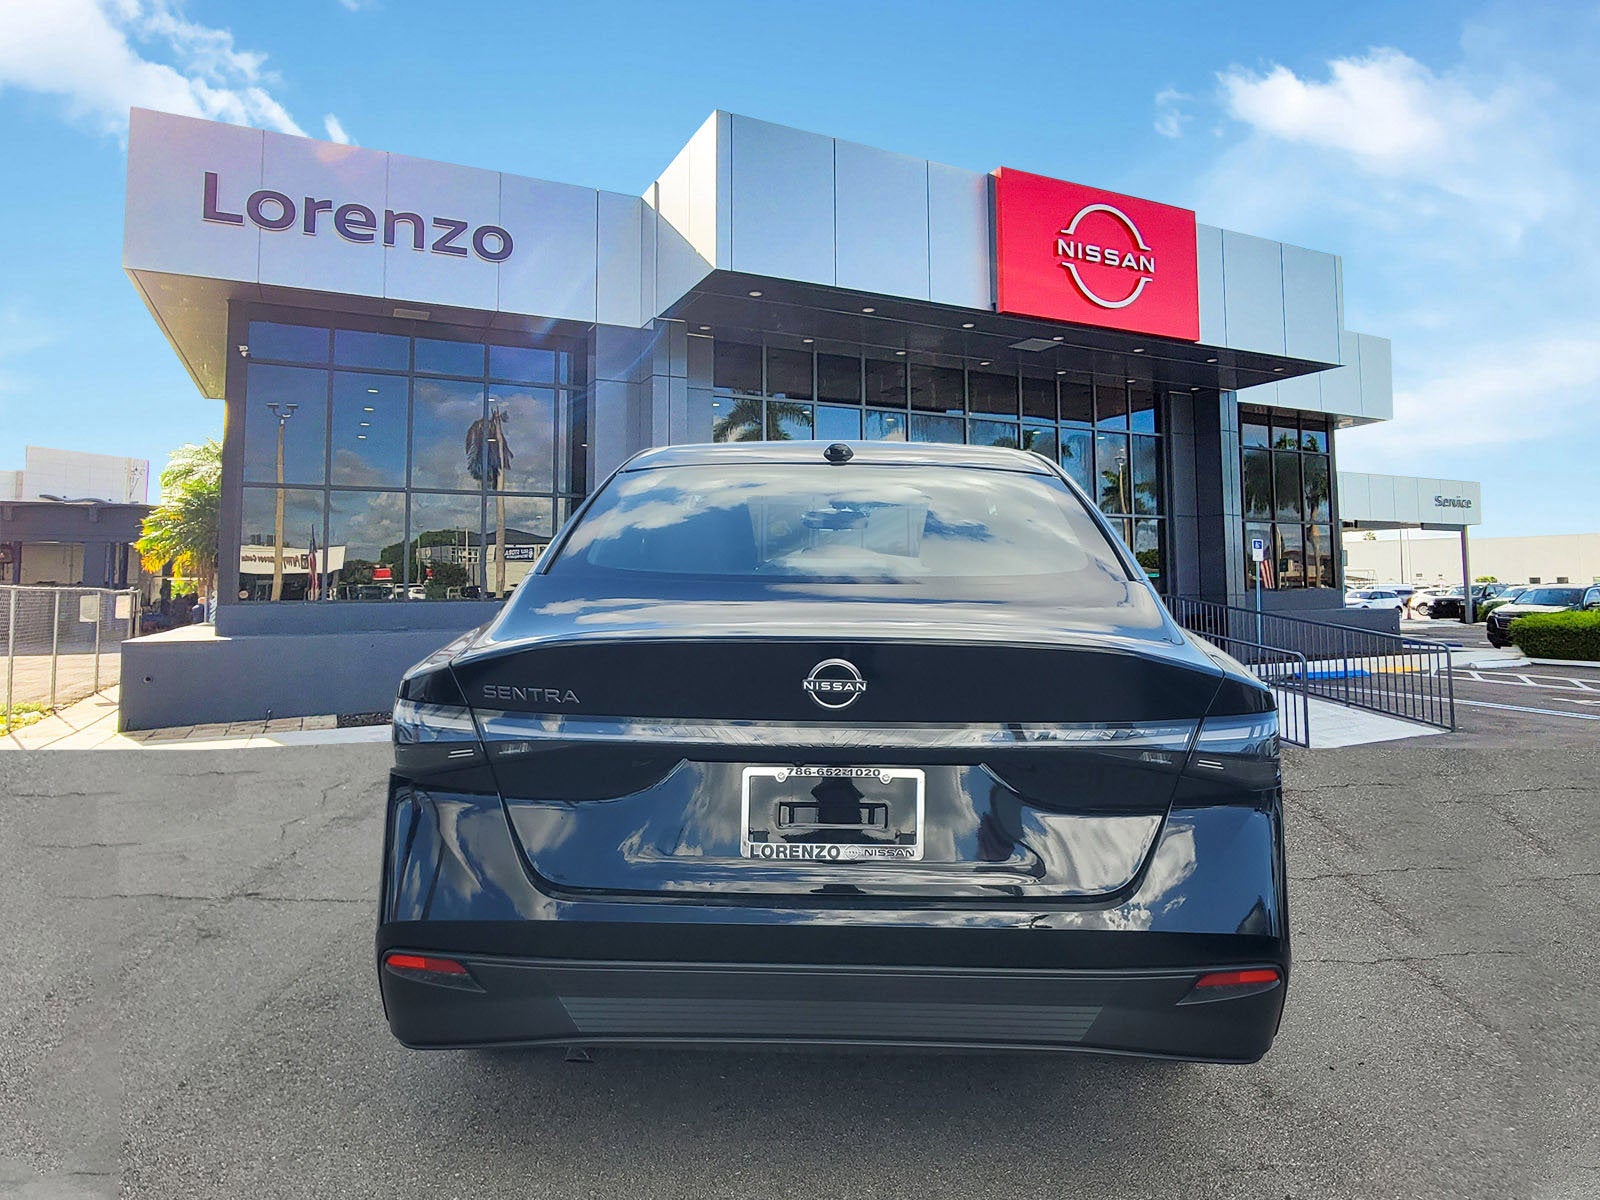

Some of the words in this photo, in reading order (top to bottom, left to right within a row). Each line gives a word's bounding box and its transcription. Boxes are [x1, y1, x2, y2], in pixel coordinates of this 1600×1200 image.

[202, 171, 514, 262] Lorenzo
[1057, 238, 1156, 273] NISSAN
[1434, 495, 1472, 508] Service
[482, 684, 581, 704] SENTRA
[803, 681, 867, 692] NISSAN
[786, 767, 881, 777] 786-652-1020
[750, 844, 841, 859] LORENZO
[864, 849, 915, 857] NISSAN
